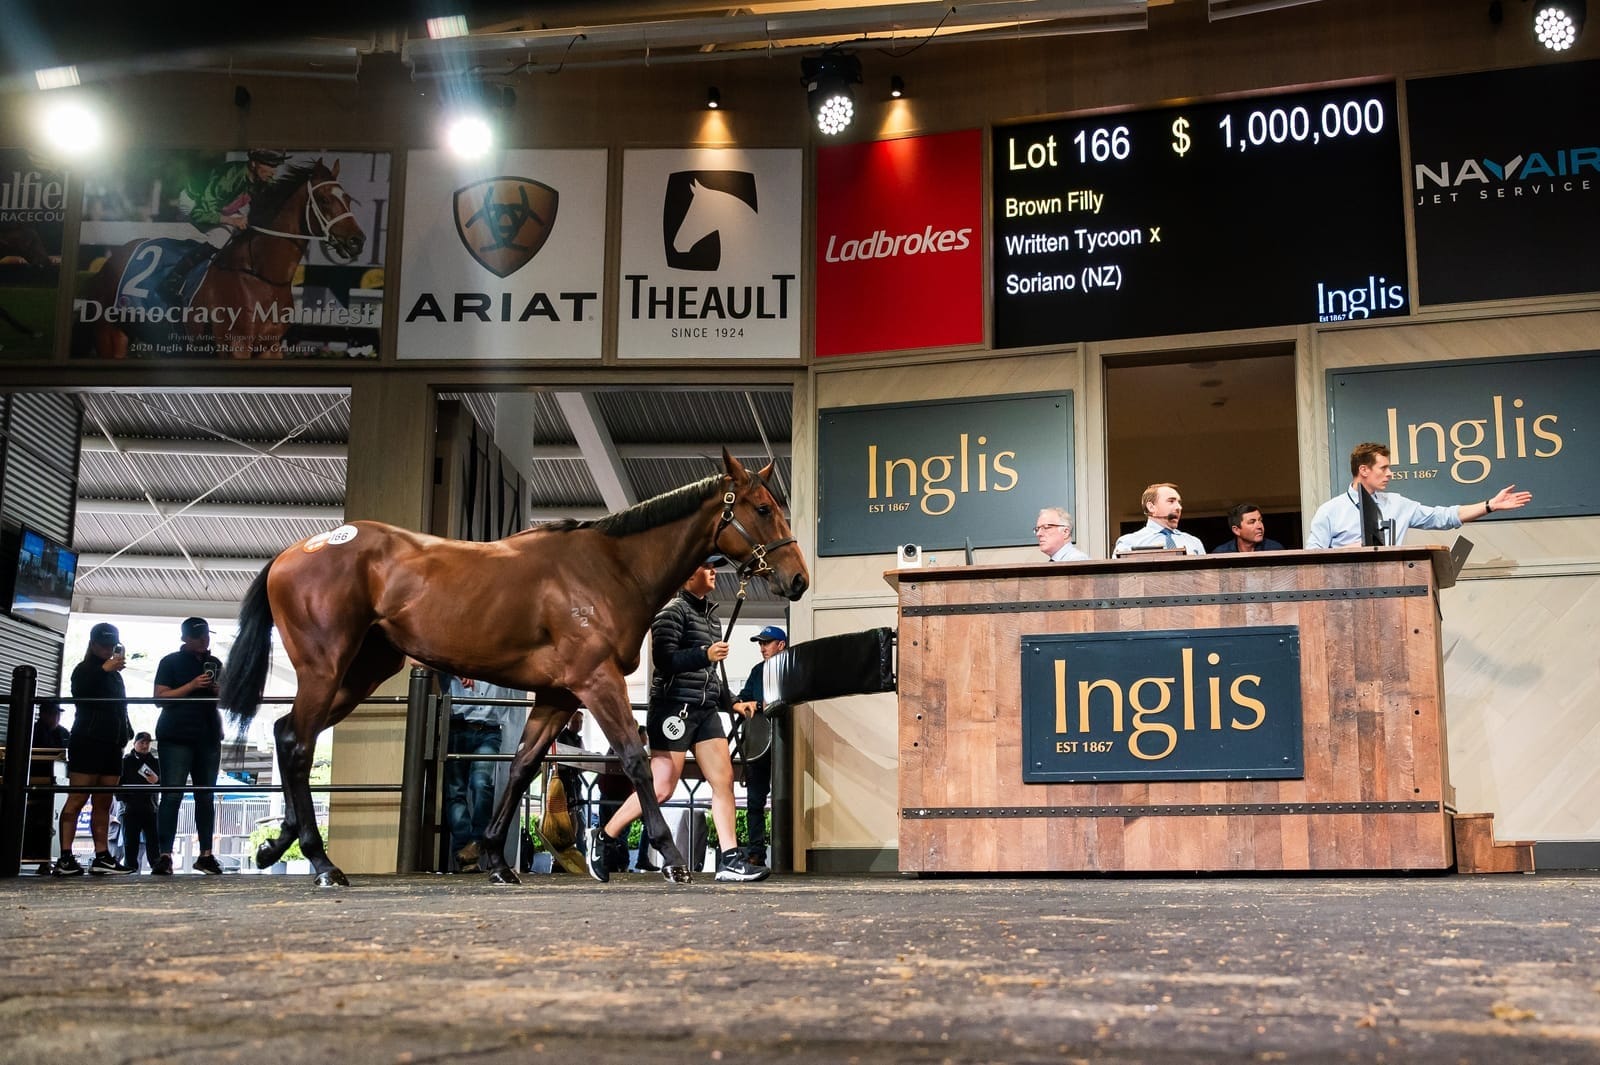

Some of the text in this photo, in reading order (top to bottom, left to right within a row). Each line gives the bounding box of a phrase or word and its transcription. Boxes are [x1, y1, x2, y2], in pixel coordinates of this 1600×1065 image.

[1008, 98, 1385, 171] Lot 166 $ 1,000,000
[1415, 147, 1600, 190] NAVAIR
[1005, 190, 1105, 218] Brown Filly
[1417, 180, 1591, 206] JET SERVICE
[825, 225, 973, 263] Ladbrokes
[1005, 225, 1162, 256] Written Tycoon x
[121, 245, 164, 299] 2
[1005, 264, 1123, 295] Soriano (NZ)
[404, 292, 598, 322] ARIAT
[624, 274, 796, 320] THEAULT
[1317, 275, 1405, 320] Inglis
[79, 299, 375, 331] Democracy Manifest
[130, 343, 316, 353] 2020 Inglis Ready2Race Sale Graduate
[671, 327, 745, 338] SINCE 1924
[1387, 395, 1564, 485] Inglis
[868, 433, 1019, 516] Inglis
[1391, 469, 1439, 480] EST 1867
[868, 502, 911, 513] EST 1867
[1054, 647, 1267, 761] Inglis
[667, 723, 680, 736] 166
[1055, 740, 1114, 753] EST 1867
